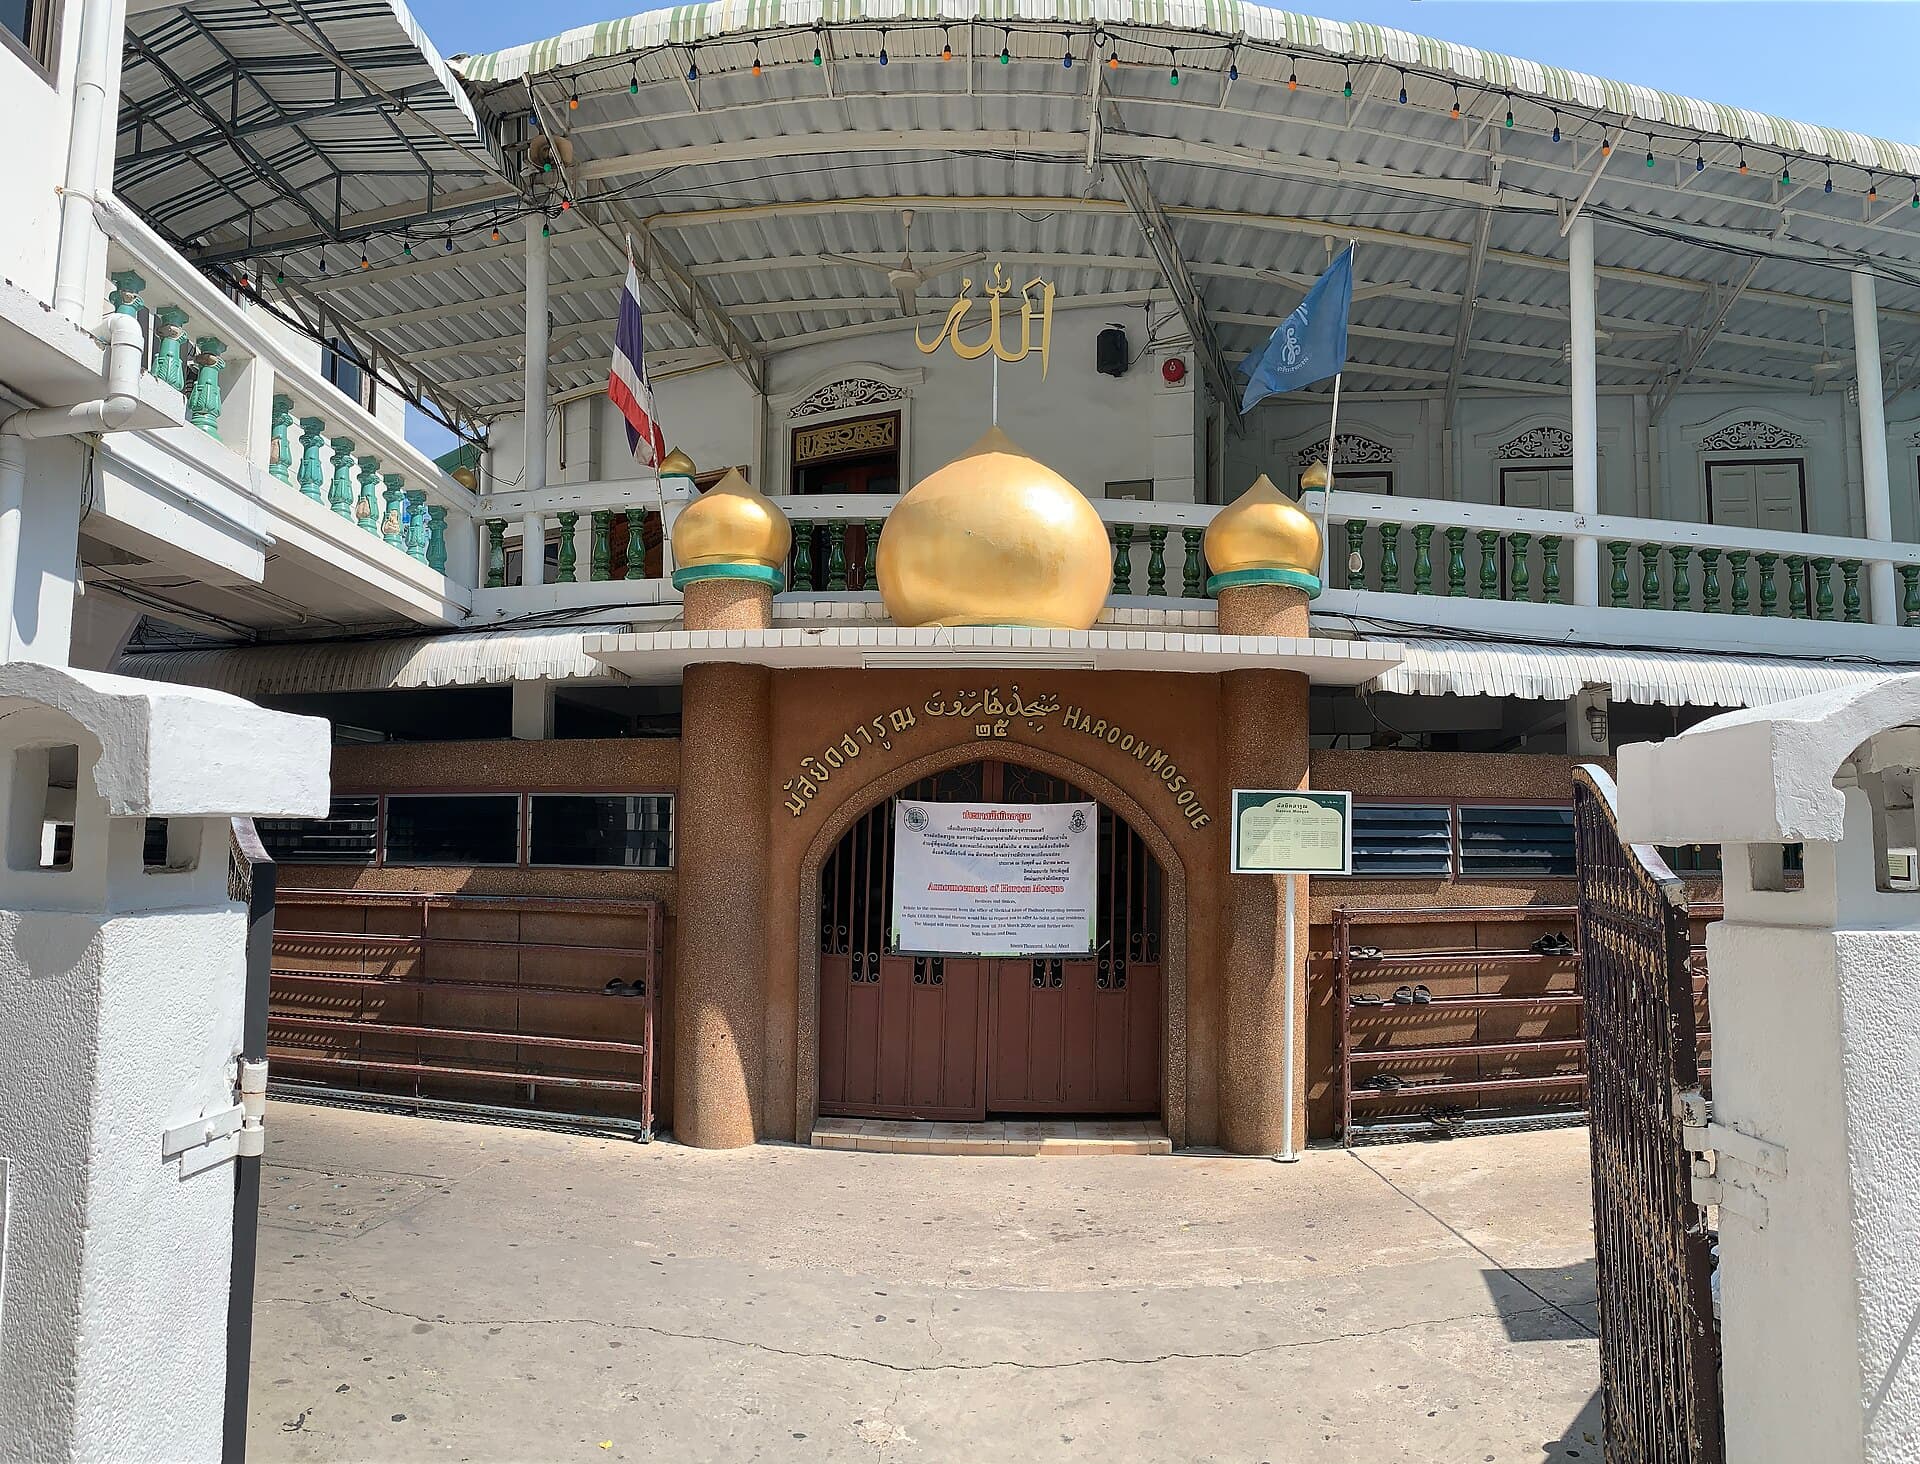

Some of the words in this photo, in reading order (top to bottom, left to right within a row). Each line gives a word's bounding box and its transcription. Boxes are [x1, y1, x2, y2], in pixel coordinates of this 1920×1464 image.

[783, 706, 917, 817] มัสยิดฮารูณ
[1063, 705, 1151, 760] HAROON
[1145, 750, 1211, 830] MOSQUE
[927, 882, 988, 893] Announcement
[990, 883, 999, 893] of
[1000, 883, 1031, 893] Haroon
[1032, 883, 1065, 894] Mosque
